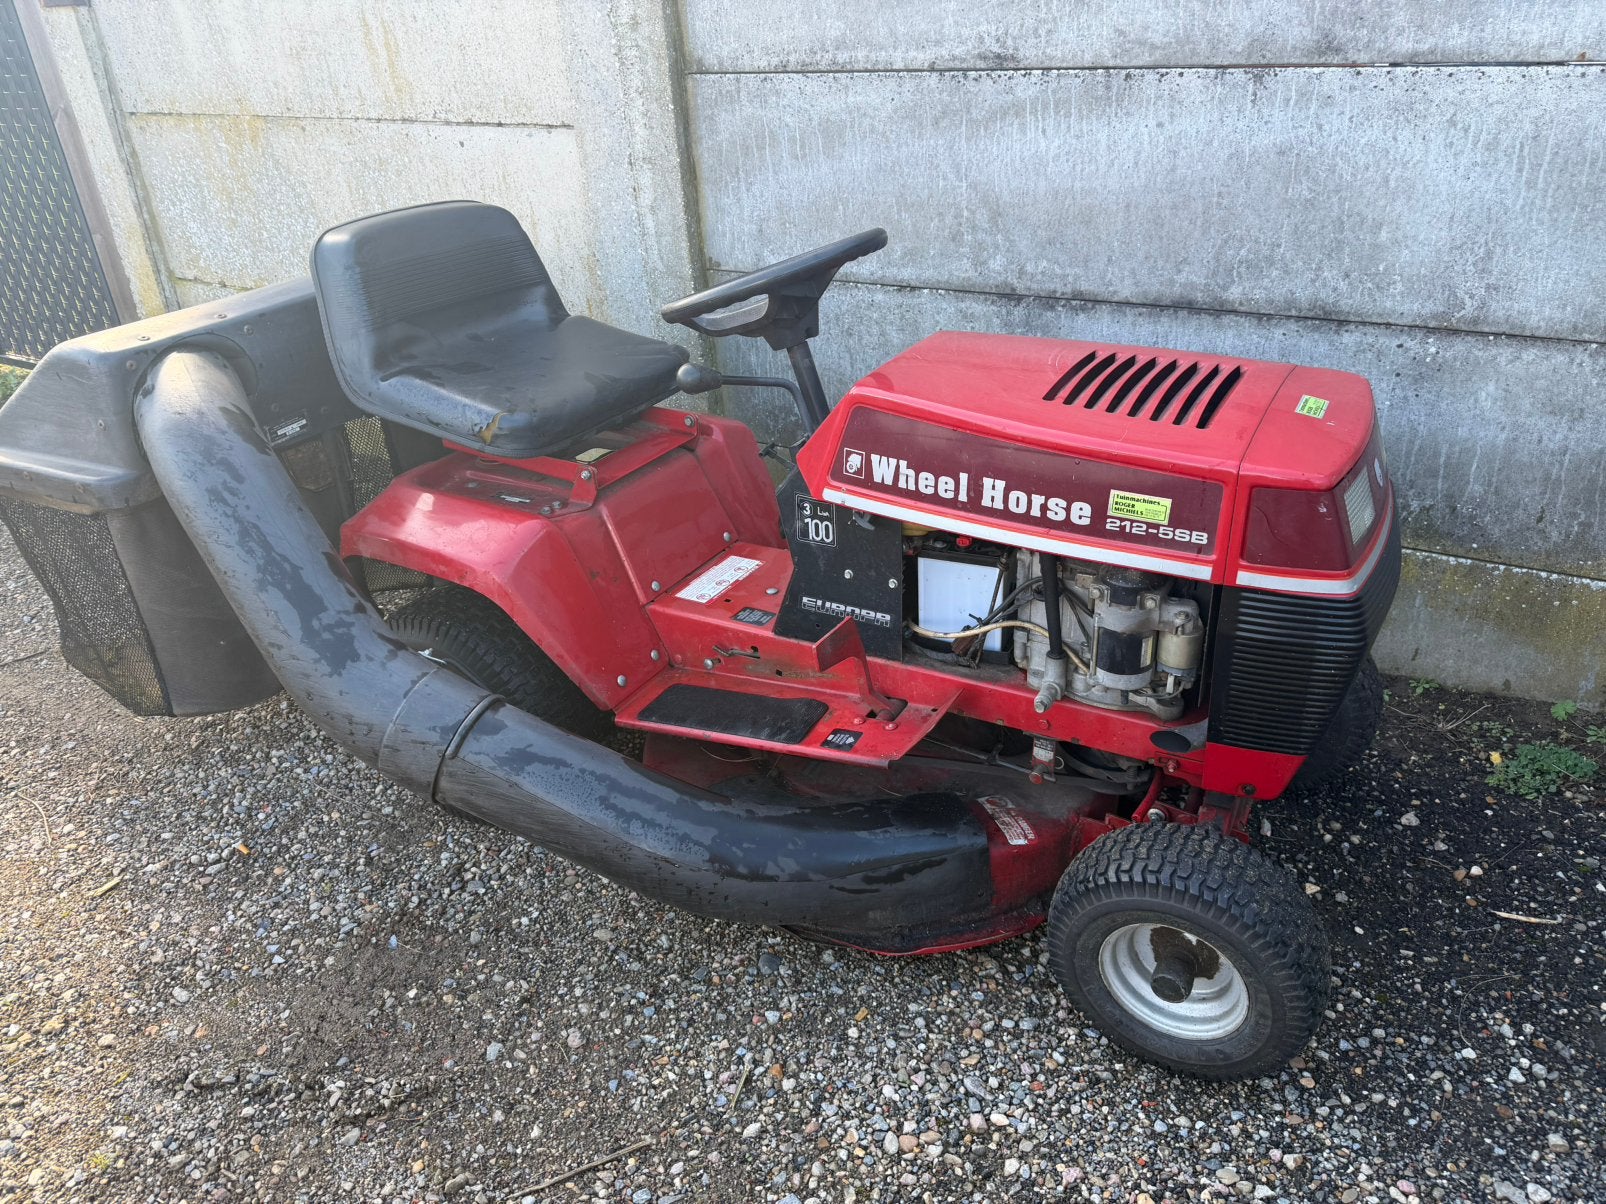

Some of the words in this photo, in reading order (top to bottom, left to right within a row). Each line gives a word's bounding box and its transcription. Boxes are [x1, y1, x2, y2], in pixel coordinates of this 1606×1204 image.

[870, 454, 968, 502] Wheel
[981, 476, 1092, 526] Horse
[1115, 493, 1161, 506] Tuinmachines
[803, 503, 811, 516] 3
[1113, 506, 1144, 516] MICHIELS
[1114, 500, 1136, 509] ROGER
[804, 517, 834, 543] 100
[1105, 518, 1209, 546] 212-5SB
[801, 596, 891, 628] EUROPA
